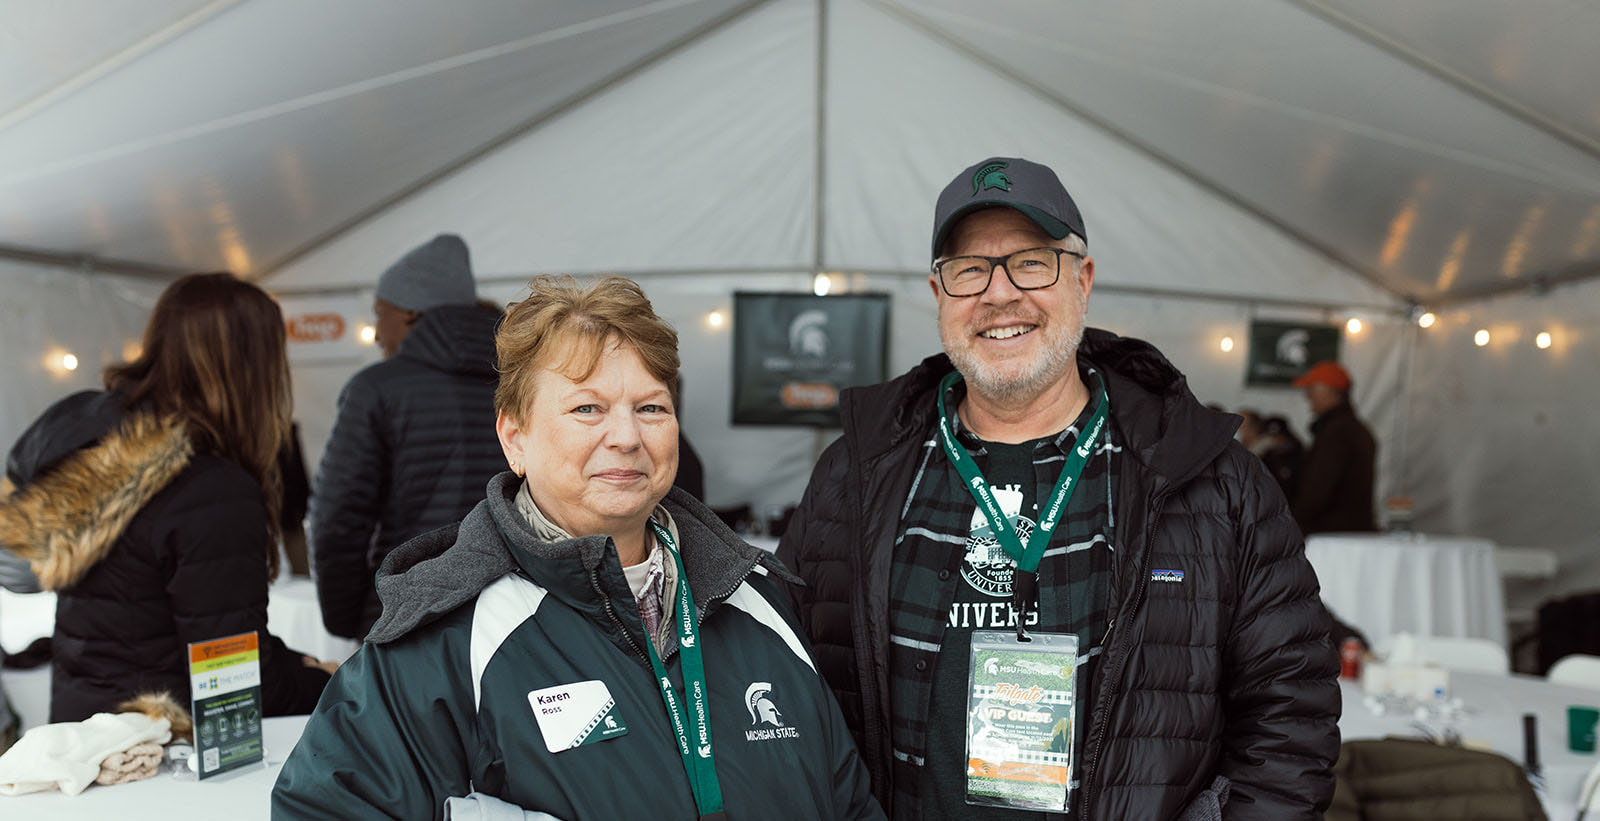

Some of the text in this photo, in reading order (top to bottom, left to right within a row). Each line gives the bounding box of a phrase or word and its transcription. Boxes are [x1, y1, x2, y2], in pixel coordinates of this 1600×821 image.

[1061, 476, 1072, 490] Care
[994, 515, 1004, 532] Care
[537, 691, 571, 705] Karen
[694, 681, 702, 699] Care
[996, 682, 1044, 706] Tailgate
[542, 706, 562, 715] Ross
[986, 708, 1051, 724] VIP GUEST
[745, 727, 796, 741] MICHIGAN STATE
[679, 735, 690, 755] Care
